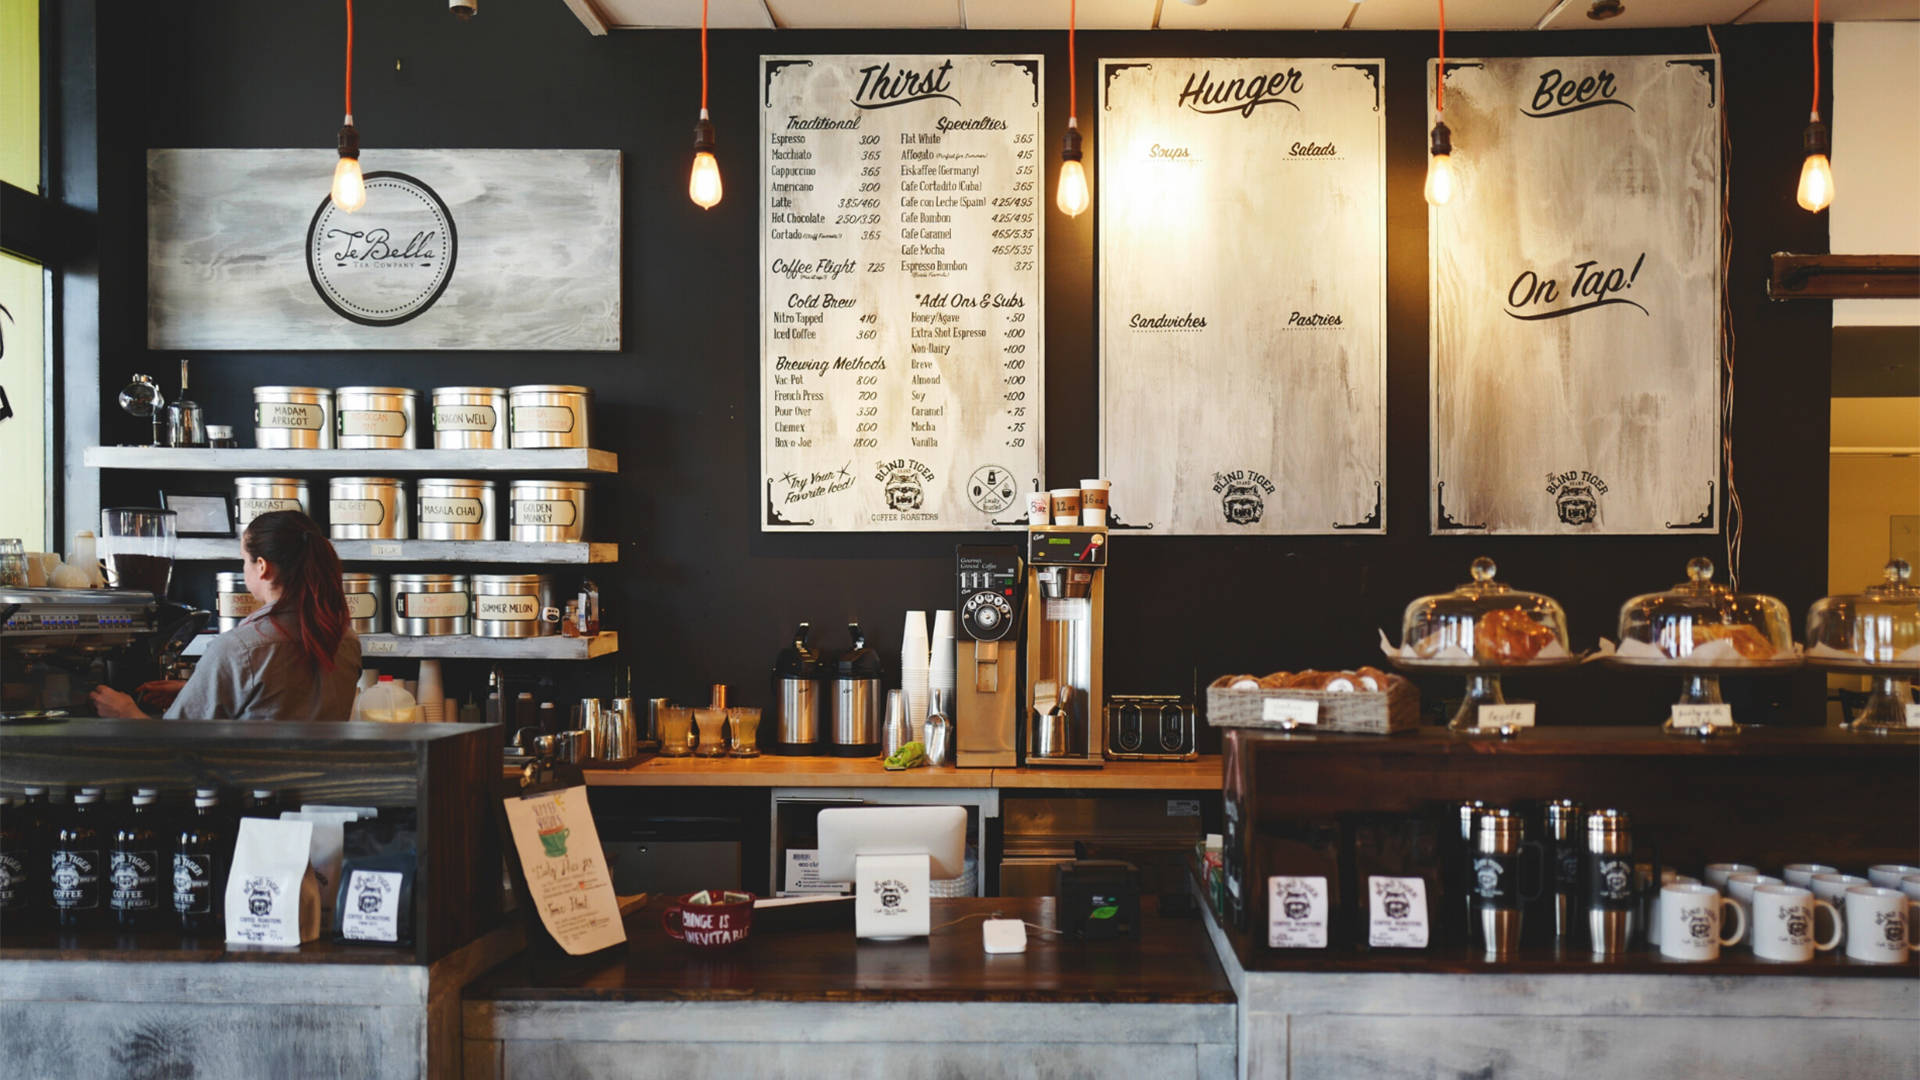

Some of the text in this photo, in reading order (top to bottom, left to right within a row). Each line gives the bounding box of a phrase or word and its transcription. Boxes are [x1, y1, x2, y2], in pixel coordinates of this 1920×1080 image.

[856, 59, 953, 102] Thirst
[1178, 67, 1304, 119] Hunger
[1531, 68, 1617, 111] Beer
[786, 115, 862, 130] Traditional
[936, 116, 1008, 134] Specialties
[771, 133, 806, 146] Espresso
[900, 133, 916, 144] Flat
[918, 133, 941, 144] White
[771, 149, 812, 160] Macchiato
[1149, 143, 1191, 160] Soups
[1288, 141, 1338, 157] Salads
[901, 149, 934, 161] Affogato
[771, 165, 816, 178] Cappuccino
[901, 165, 936, 176] Eiskaffee
[771, 182, 814, 191] Americano
[901, 181, 918, 191] Cafe
[920, 181, 957, 191] Cortadito
[771, 197, 792, 207] Latte
[901, 196, 918, 207] Cafe
[920, 198, 934, 207] con
[936, 196, 958, 207] Leche
[771, 212, 784, 223] Hot
[786, 212, 825, 223] Chocolate
[901, 212, 918, 223] Cafe
[771, 228, 802, 239] Cortado
[901, 228, 918, 239] Cafe
[920, 228, 951, 239] Caramel
[901, 244, 918, 255] Cafe
[920, 244, 945, 255] Mocha
[771, 258, 813, 280] Coffee
[815, 258, 856, 280] Flight
[901, 260, 936, 273] Espresso
[1508, 252, 1645, 308] On Tap!
[788, 293, 857, 308] Cold Brew
[950, 293, 977, 308] Ons
[980, 293, 991, 308] &
[992, 292, 1025, 308] Subs
[774, 312, 794, 323] Nitro
[796, 312, 824, 326] Tapped
[1129, 312, 1208, 329] Sandwiches
[1288, 311, 1344, 327] Pastries
[774, 328, 790, 339] Iced
[792, 328, 816, 339] Coffee
[911, 327, 986, 340] Extra Shot Espresso
[775, 356, 886, 377] Brewing Methods
[911, 359, 932, 369] Breve
[774, 375, 803, 384] Vac Pot
[912, 374, 941, 385] Almond
[774, 390, 824, 400] French Press
[912, 390, 926, 402] Soy
[274, 406, 307, 416] MADAM
[774, 405, 792, 416] Pour
[794, 405, 812, 416] Over
[912, 406, 944, 416] Caramel
[272, 417, 309, 426] APRICOT
[465, 414, 488, 425] WELL
[774, 422, 805, 432] Chemex
[911, 422, 936, 431] Mocha
[912, 437, 938, 447] Vanilla
[875, 458, 935, 482] BLIND TIGER
[790, 472, 835, 491] Try Your
[1212, 470, 1276, 495] BLIND TIGER
[1546, 470, 1609, 496] BLIND TIGER
[784, 476, 856, 504] Favorite Iced!
[1084, 493, 1094, 504] 16
[424, 505, 476, 516] MASALA CHAI
[1031, 502, 1037, 513] 8
[1056, 501, 1066, 512] 12
[871, 513, 939, 521] COFFEE ROASTERS
[481, 603, 533, 613] SUMMER MELON
[69, 854, 92, 872] TIGER
[127, 854, 151, 873] TIGER
[182, 855, 204, 877] TIGER
[53, 889, 84, 898] COFFEE
[113, 889, 144, 898] COFFEE
[682, 910, 730, 929] CHANGE IS
[685, 926, 749, 946] INEVITABLE
